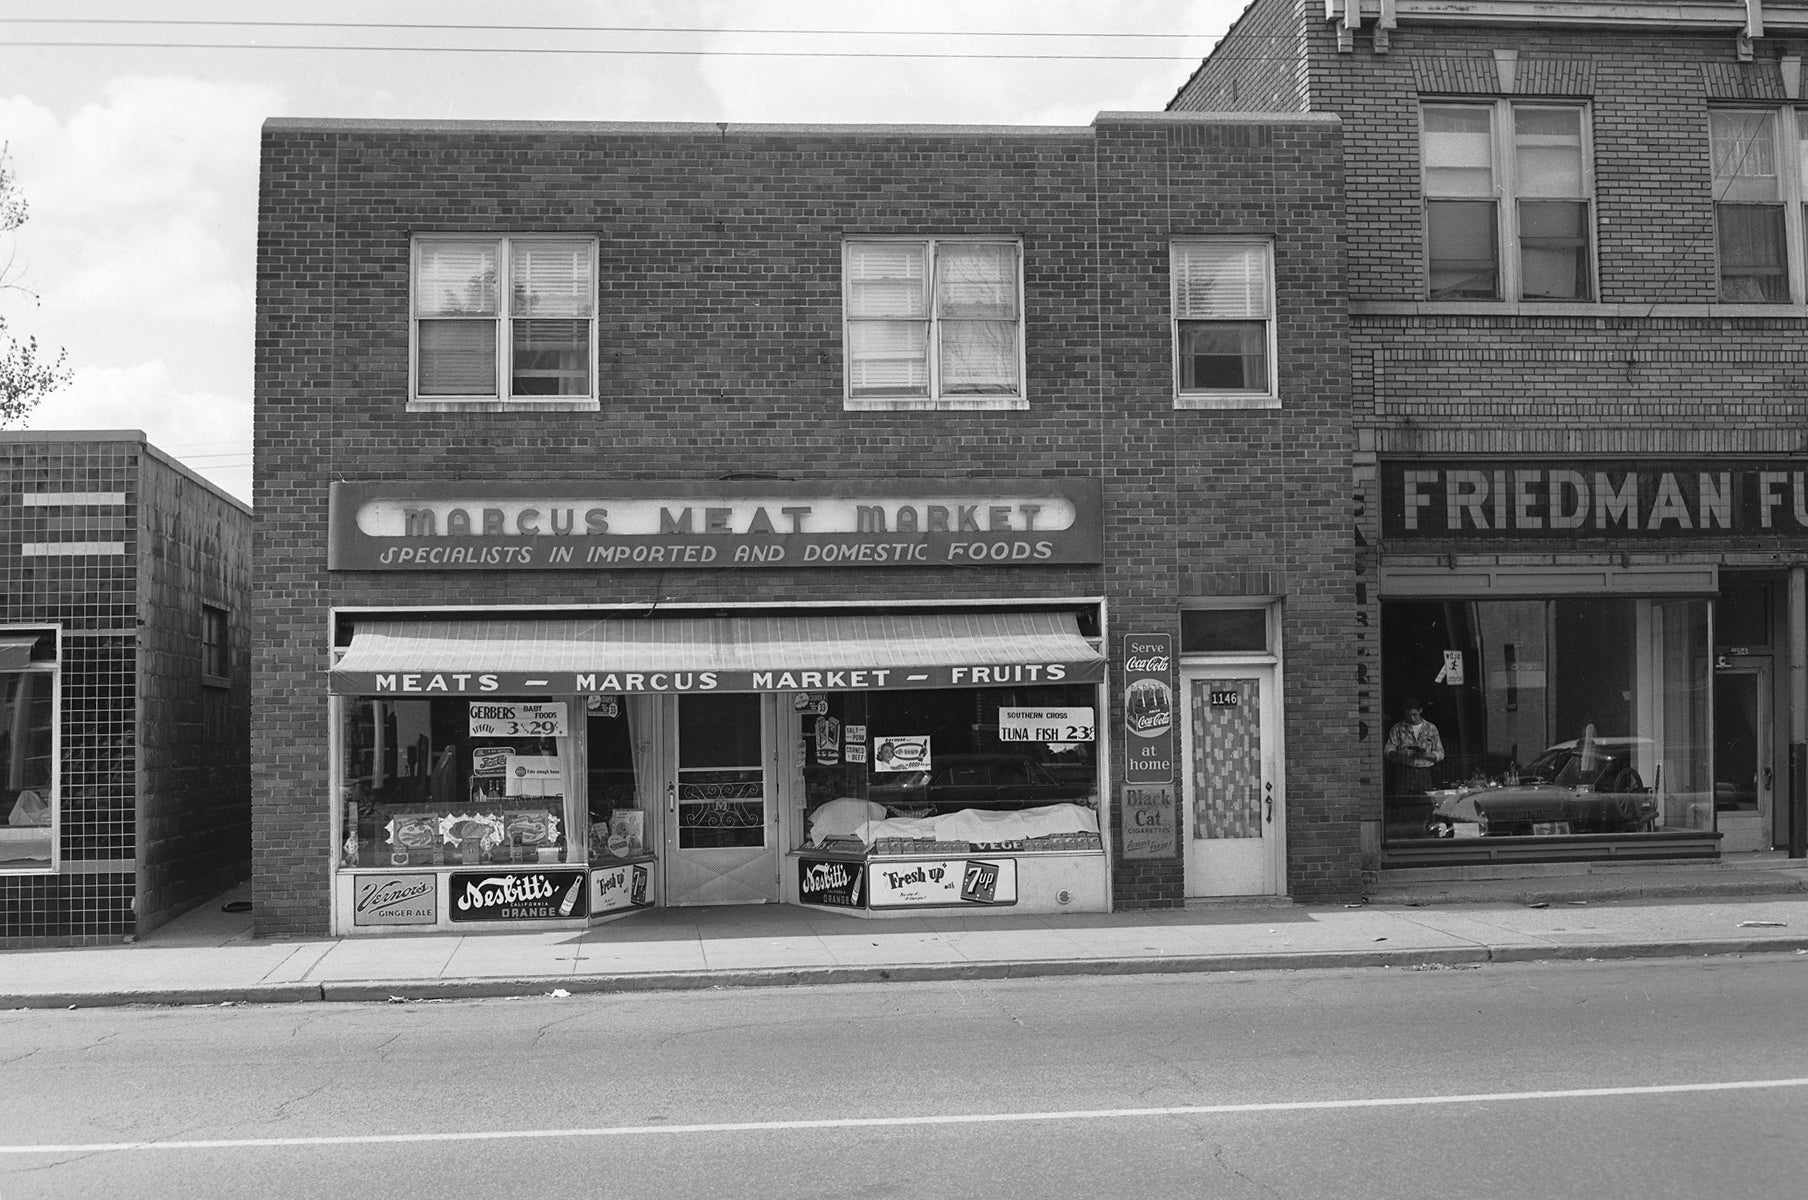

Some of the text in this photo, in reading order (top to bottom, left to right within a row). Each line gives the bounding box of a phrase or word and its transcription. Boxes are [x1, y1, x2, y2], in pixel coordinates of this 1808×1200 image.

[1403, 470, 1732, 530] FRIEDMAN
[403, 504, 1041, 536] MARCUS MEAT MARKET
[380, 541, 1054, 564] SPECIALISTS IN IMPORTED AND DOMESTIC FOODS
[1131, 642, 1165, 653] Serve
[375, 673, 500, 692] MEATS
[576, 672, 719, 691] MARCUS
[752, 669, 890, 689] MARKET
[951, 664, 1067, 684] FRUITS
[1212, 692, 1237, 704] 1146
[470, 705, 516, 719] GERBERS
[535, 711, 557, 719] FOODS
[506, 721, 520, 735] 3
[1001, 727, 1029, 740] TUNA
[1036, 727, 1059, 740] FISH
[1141, 745, 1158, 757] at
[1130, 758, 1170, 770] home
[1127, 789, 1171, 807] Black
[1135, 810, 1161, 826] Cat
[802, 862, 848, 894] Nesbitt's
[357, 880, 433, 914] Vernor's
[457, 875, 554, 911] Nesbitt's
[823, 894, 850, 905] ORANGE
[501, 907, 556, 918] ORANGE
